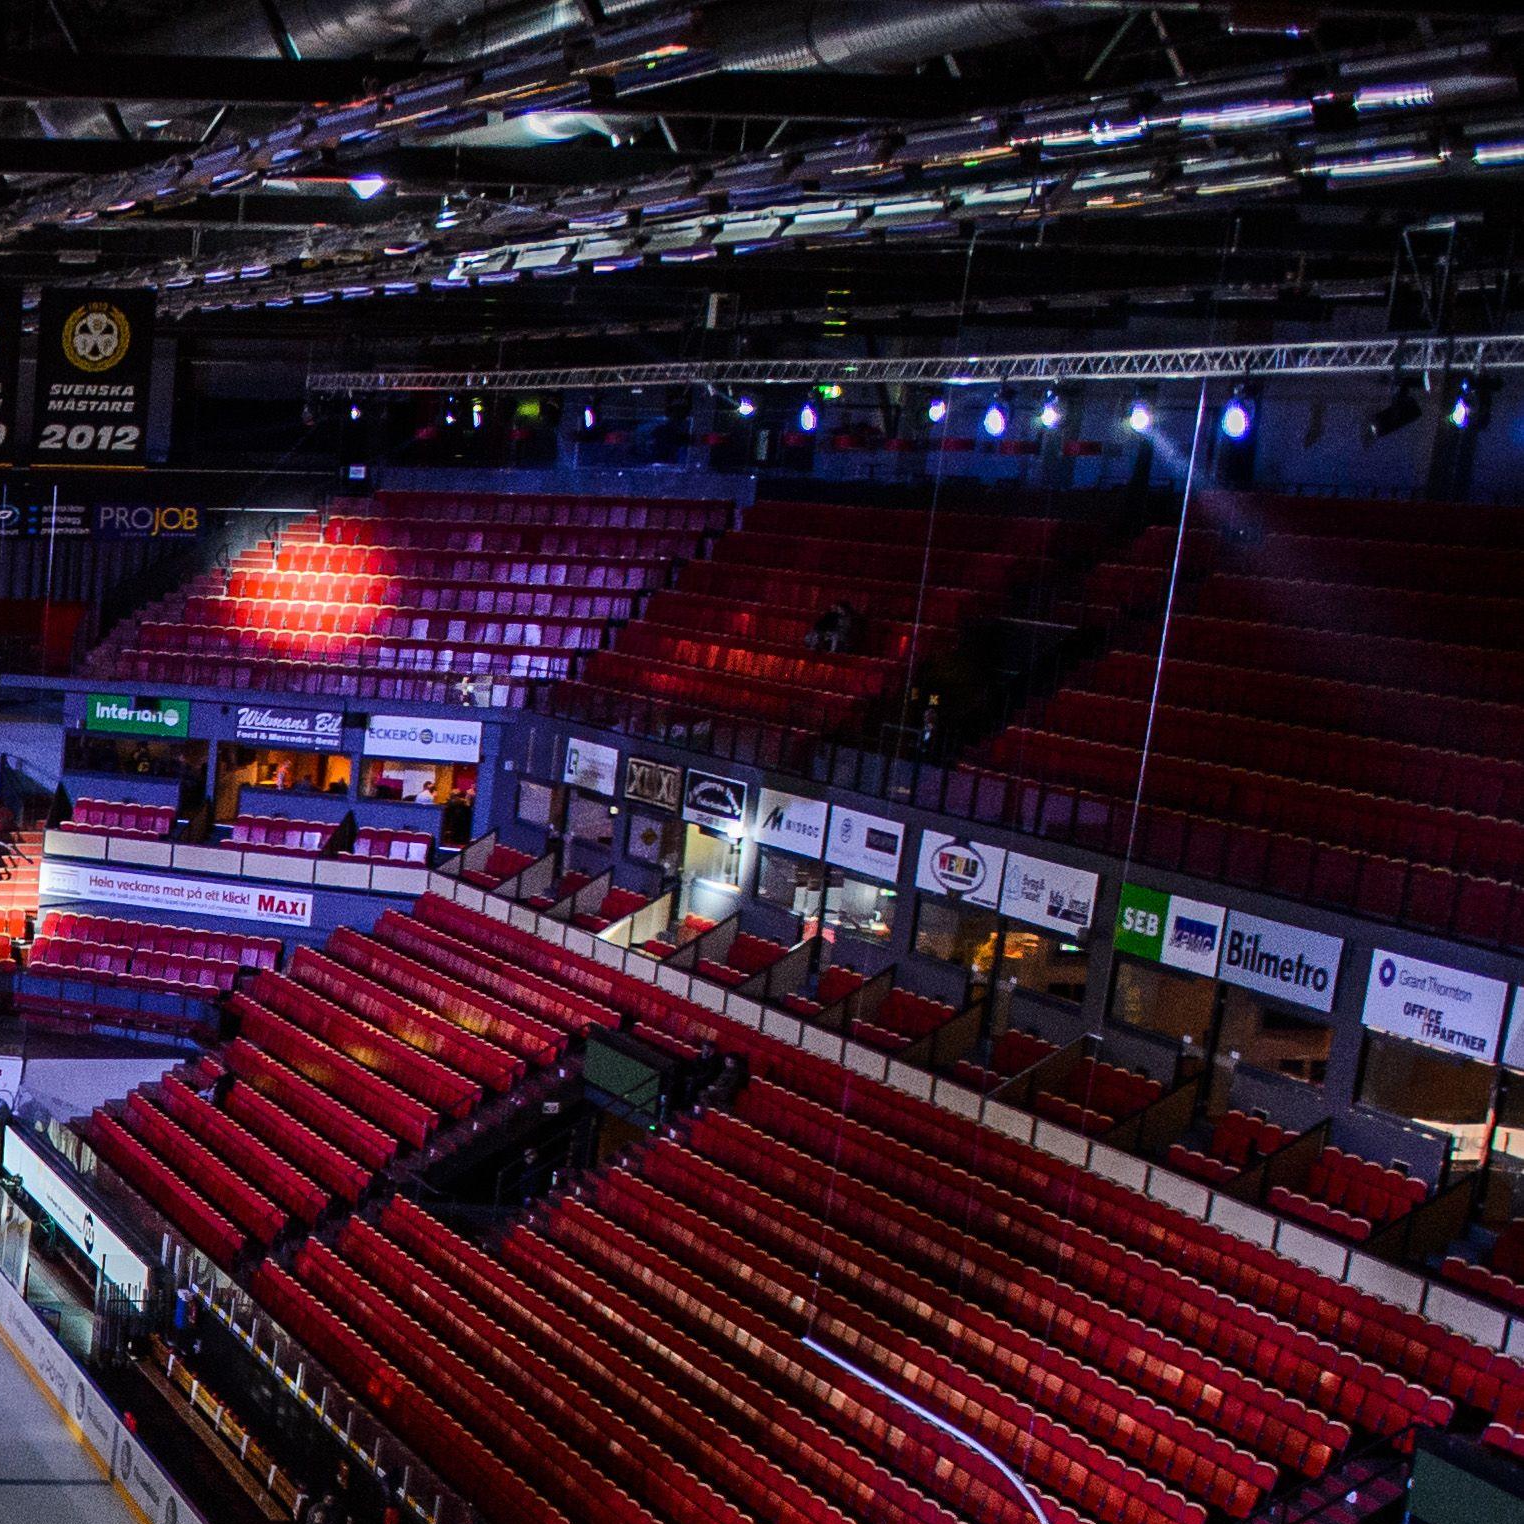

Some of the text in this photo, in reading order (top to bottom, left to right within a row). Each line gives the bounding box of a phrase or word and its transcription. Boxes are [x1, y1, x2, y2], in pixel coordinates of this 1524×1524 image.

[49, 384, 135, 396] SVENSKA
[38, 425, 140, 451] 2012
[100, 507, 199, 535] PROJOB
[238, 707, 344, 734] Wikmans Bil
[369, 727, 478, 747] ECKERÖ LINJEN
[89, 875, 114, 888] Hela
[116, 880, 160, 896] veckans
[162, 883, 184, 897] mat
[186, 883, 202, 901] på
[205, 889, 221, 901] ett
[222, 892, 250, 906] klick!
[257, 894, 306, 917] MAXI
[1121, 905, 1159, 937] SEB
[1225, 928, 1329, 993] Bilmetro
[1403, 1001, 1444, 1025] OFFICE
